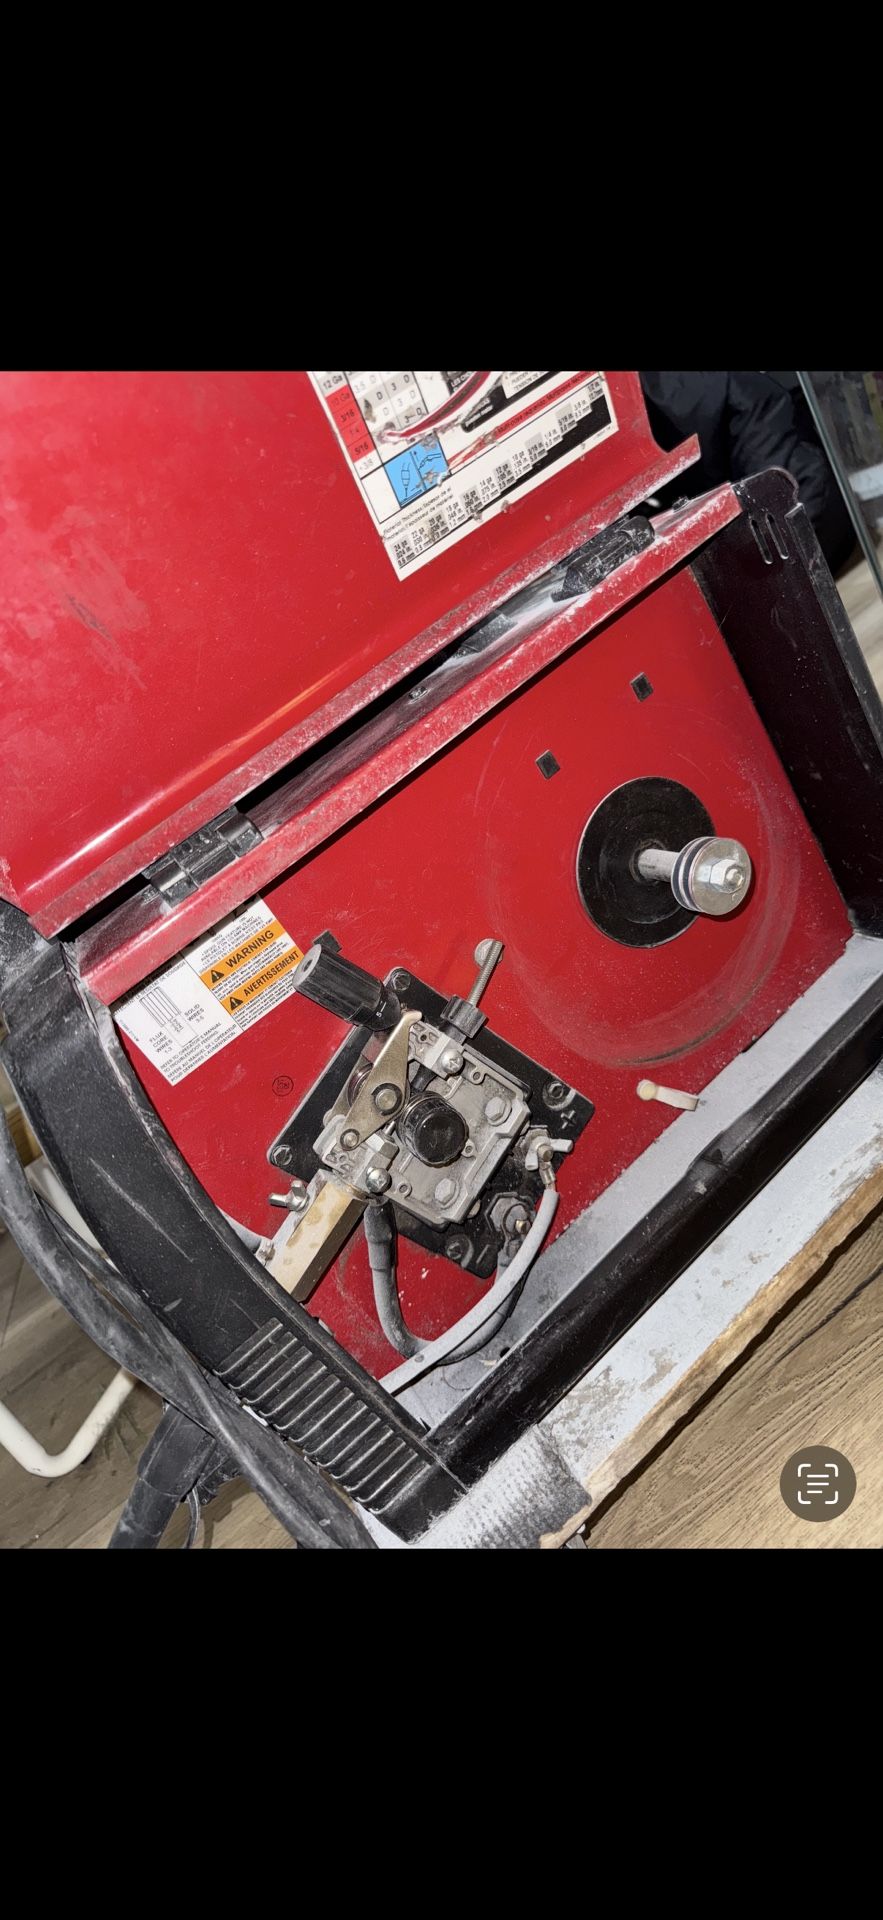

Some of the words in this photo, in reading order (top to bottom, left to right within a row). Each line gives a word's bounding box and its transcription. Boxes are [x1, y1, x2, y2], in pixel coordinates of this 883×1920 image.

[323, 380, 332, 389] 12
[391, 382, 396, 391] 3
[393, 542, 401, 552] 24
[224, 928, 275, 968] WARNING
[241, 951, 300, 995] AVERTISSEMENT
[183, 1003, 200, 1016] SOLID
[187, 1007, 204, 1022] WIRES
[148, 1030, 163, 1043] FLUX
[152, 1034, 168, 1048] CORE
[155, 1038, 173, 1053] WIRES
